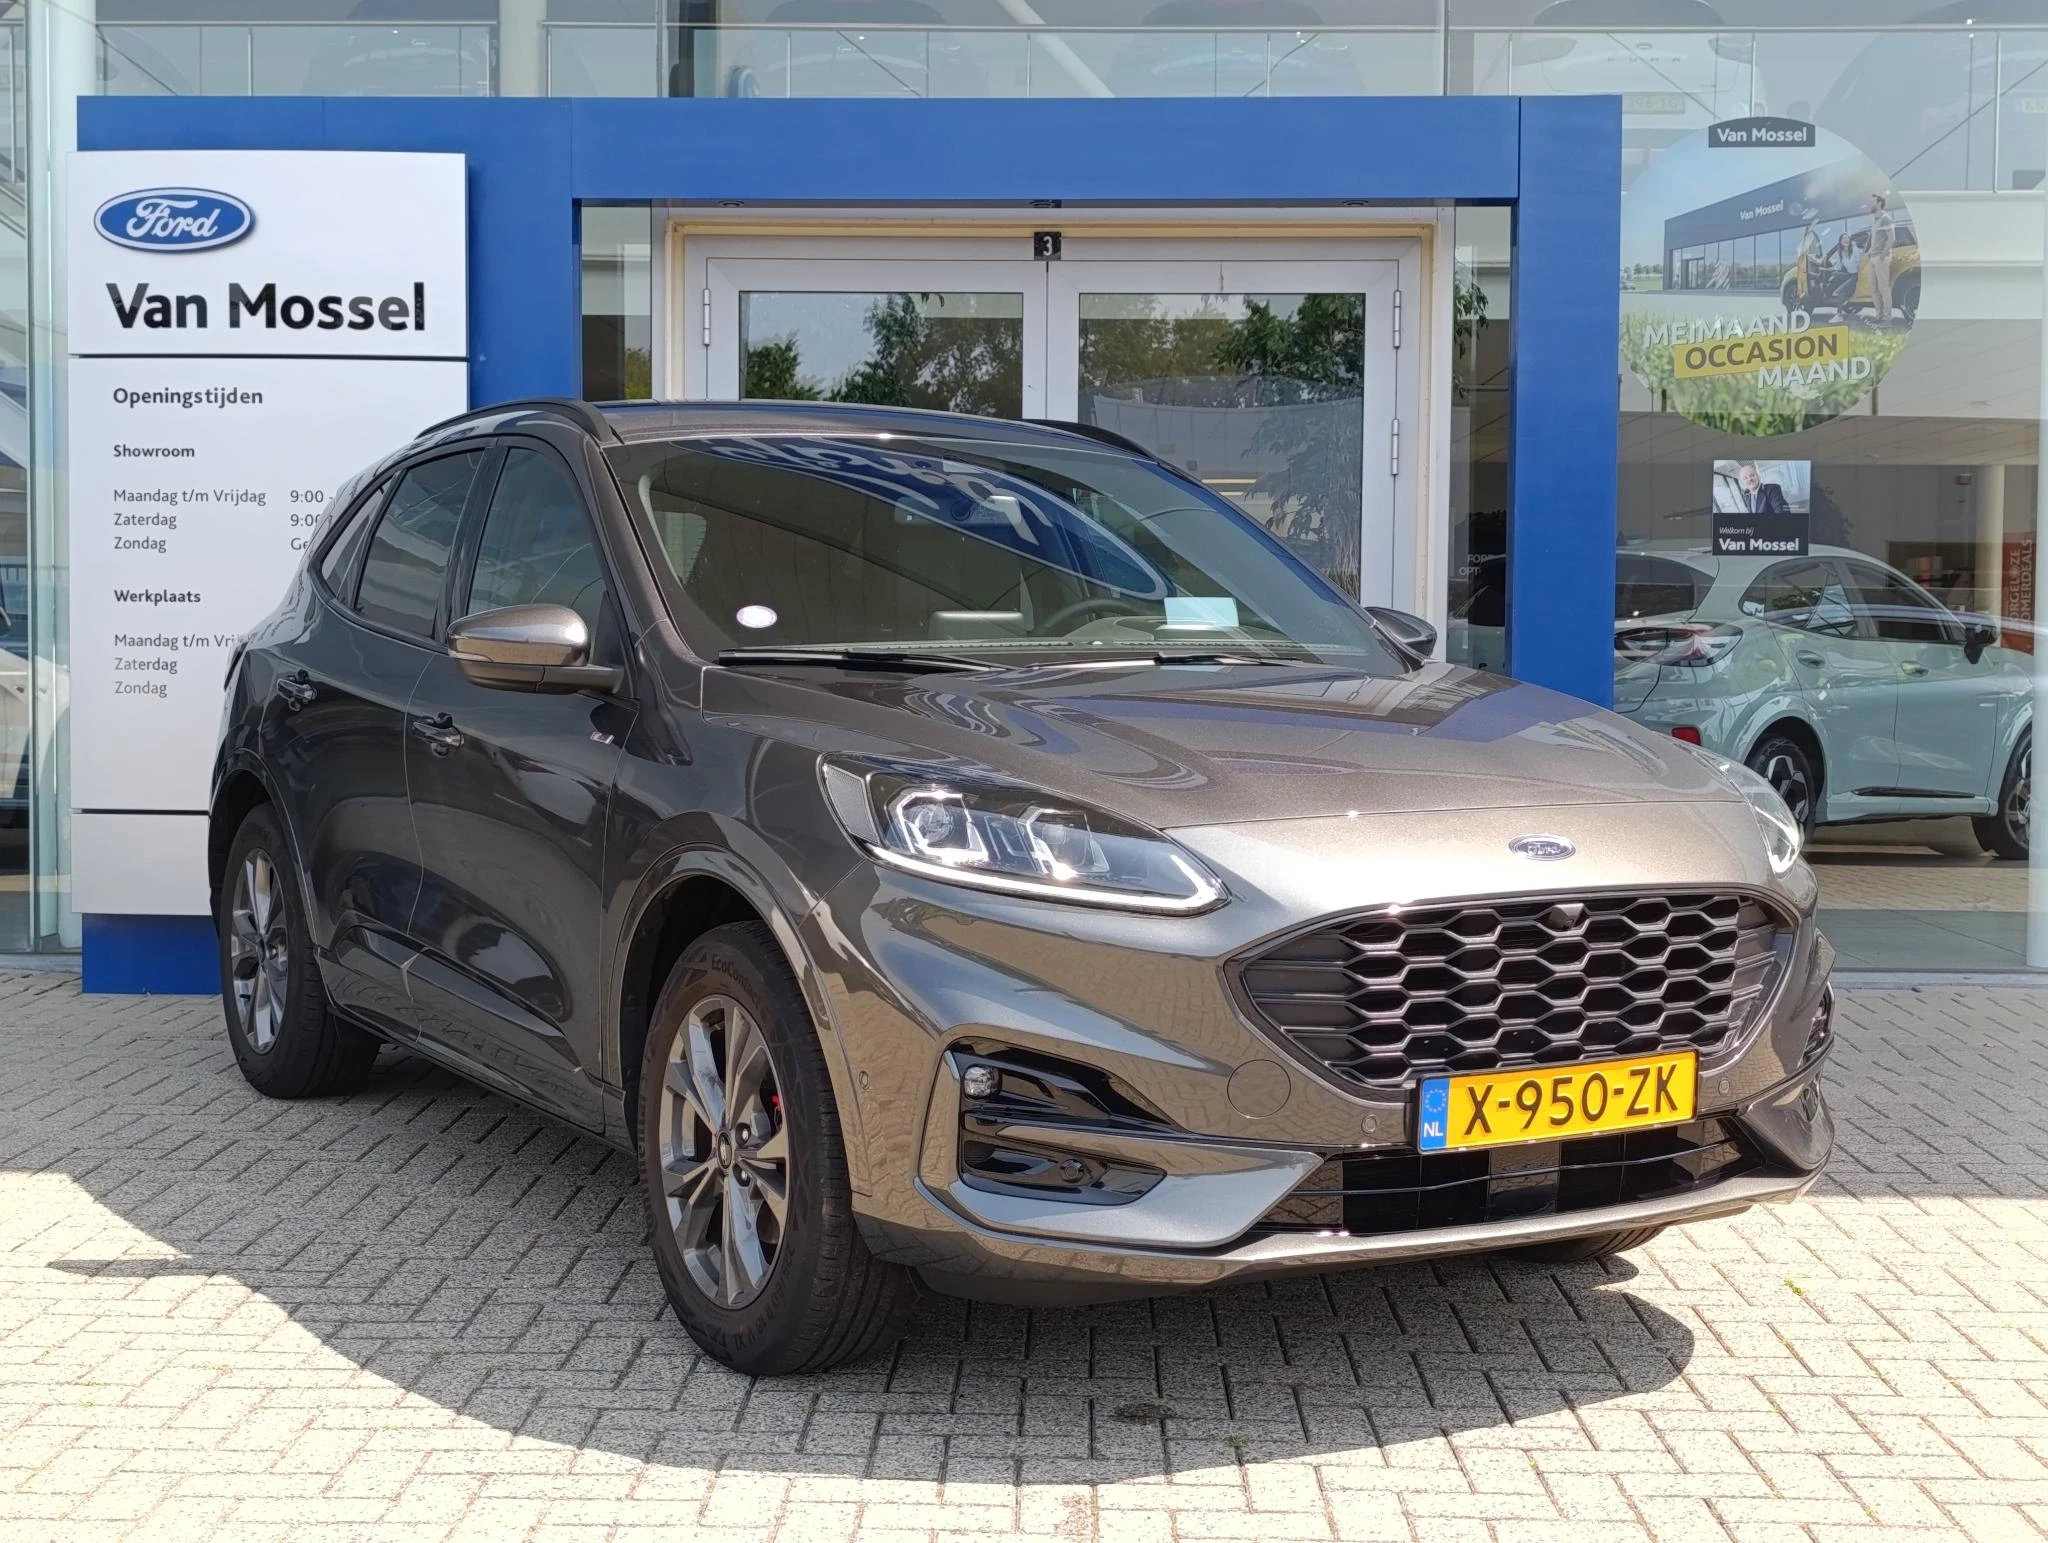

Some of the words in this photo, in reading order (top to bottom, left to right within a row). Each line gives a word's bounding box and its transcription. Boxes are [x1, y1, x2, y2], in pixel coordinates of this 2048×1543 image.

[1717, 127, 1747, 142] Van
[1752, 126, 1807, 142] Mossel
[125, 197, 222, 238] Ford
[1740, 210, 1754, 220] Van
[1755, 200, 1784, 217] Mossel
[1043, 235, 1053, 257] 3
[105, 282, 208, 329] Van
[228, 281, 426, 331] Mossel
[1644, 310, 1811, 347] MEIMAAND
[1685, 333, 1838, 370] OCCASION
[1758, 356, 1872, 390] MAAND
[113, 387, 263, 409] Openingstijden
[113, 444, 195, 458] Showroom
[113, 488, 178, 507] Maandag
[182, 488, 209, 504] t/m
[213, 489, 266, 507] Vrijdag
[290, 489, 324, 503] 9:00
[113, 512, 177, 530] Zaterdag
[1719, 527, 1745, 535] Welkom
[1746, 527, 1755, 537] bij
[113, 536, 167, 554] Zondag
[1719, 537, 1746, 551] Van
[1750, 537, 1800, 552] Mossel
[113, 588, 201, 607] Werkplaats
[114, 633, 179, 652] Maandag
[183, 633, 209, 648] t/m
[114, 656, 178, 675] Zaterdag
[114, 680, 168, 699] Zondag
[1423, 1122, 1444, 1138] NL
[1464, 1063, 1678, 1136] X-950-ZK
